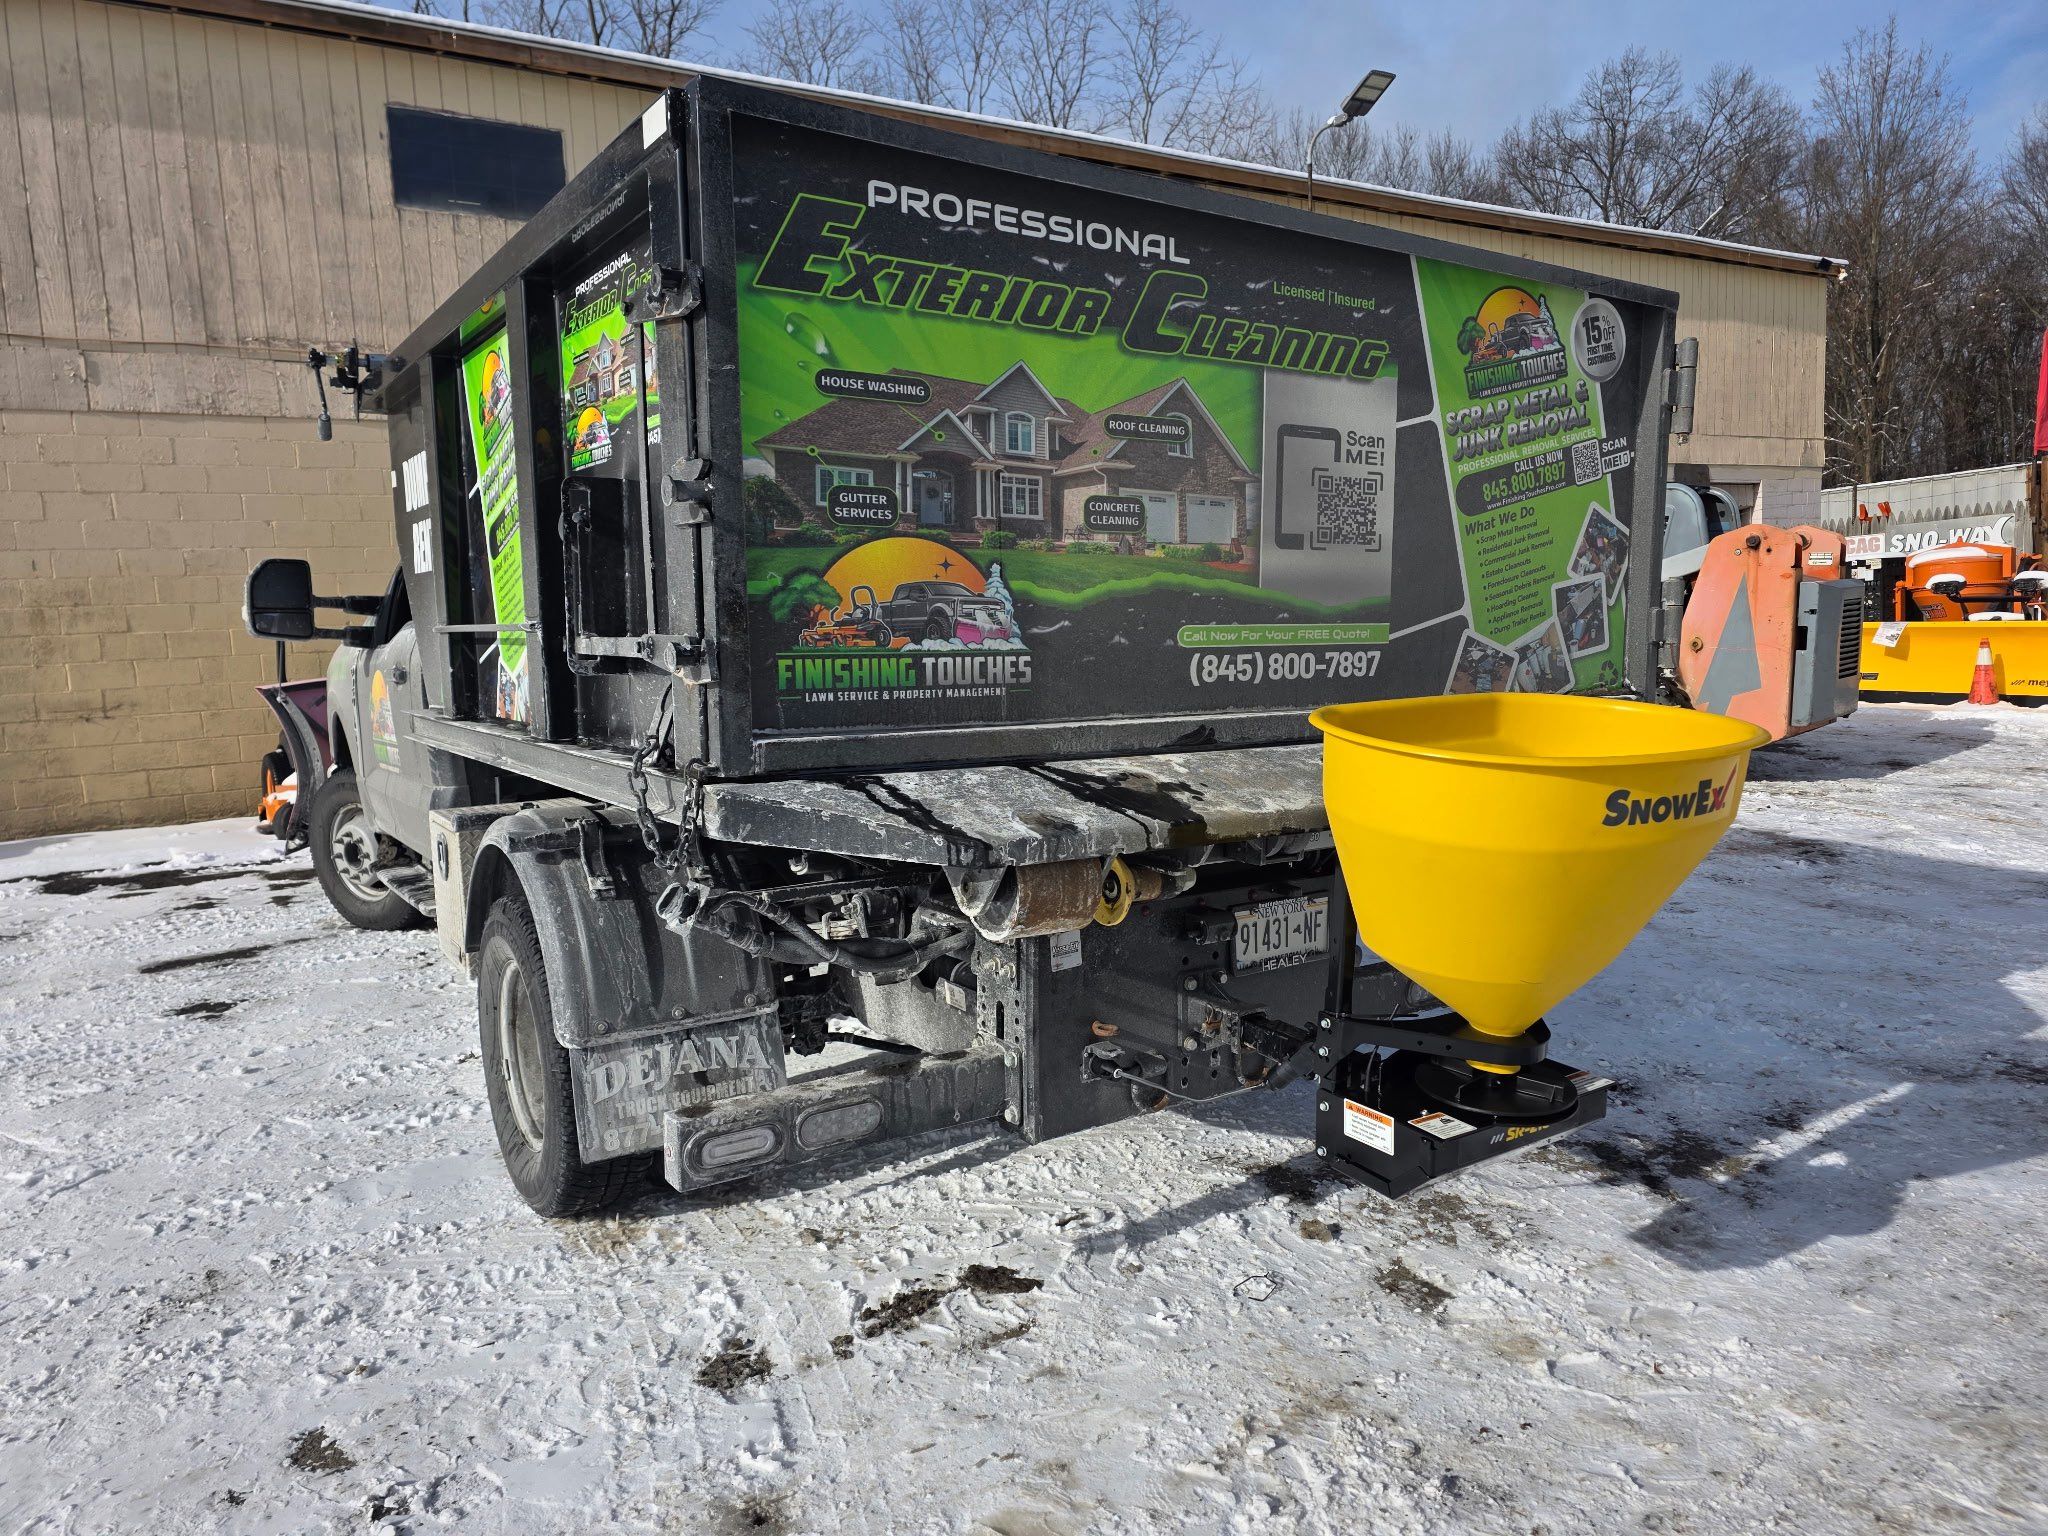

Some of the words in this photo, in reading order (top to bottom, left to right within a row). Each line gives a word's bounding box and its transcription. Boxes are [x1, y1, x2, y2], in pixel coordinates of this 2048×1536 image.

[868, 180, 1190, 264] PROFESSIONAL
[575, 252, 632, 297] PROFESSIONAL
[753, 193, 1111, 335] EXTERIOR
[1122, 270, 1389, 378] CLEANING
[1273, 281, 1325, 302] Licensed
[1334, 292, 1376, 310] Insured
[1602, 326, 1615, 341] OFF
[1467, 363, 1520, 392] FINISHING
[1520, 352, 1566, 379] TOUCHES
[821, 375, 865, 390] HOUSE
[867, 381, 925, 396] WASHING
[1446, 399, 1510, 436] SCRAP
[1514, 383, 1573, 419] METAL
[1108, 419, 1137, 432] ROOF
[1138, 422, 1185, 436] CLEANING
[1453, 426, 1504, 462] JUNK
[1507, 404, 1591, 447] REMOVAL
[1346, 430, 1385, 449] Scan
[1602, 437, 1628, 453] SCAN
[1345, 449, 1385, 466] ME!
[1457, 449, 1520, 474] PROFESSIONAL
[1522, 441, 1560, 456] REMOVAL
[1561, 428, 1597, 444] SERVICES
[1514, 460, 1534, 473] CALL
[1535, 456, 1546, 467] US
[1546, 449, 1564, 463] NOW
[1482, 461, 1567, 502] 845.800.7897
[839, 492, 887, 504] GUTTER
[1089, 501, 1141, 513] CONCRETE
[834, 506, 893, 520] SERVICES
[1090, 515, 1139, 526] CLEANING
[1465, 517, 1497, 537] What
[1499, 511, 1517, 526] We
[1520, 506, 1535, 519] Do
[1480, 533, 1497, 544] Scrap
[1514, 519, 1538, 533] Removal
[1482, 539, 1513, 555] Residential
[1183, 631, 1207, 641] Call
[1211, 631, 1238, 641] Now
[1241, 630, 1261, 640] For
[1265, 630, 1295, 640] Your
[1297, 629, 1330, 639] FREE
[1333, 629, 1371, 639] Quote!
[777, 657, 916, 690] FINISHING
[922, 655, 1032, 687] TOUCHES
[1189, 652, 1264, 687] (845)
[1268, 650, 1382, 681] 800-7897
[805, 692, 834, 703] LAWN
[837, 690, 879, 701] SERVICE
[882, 690, 890, 700] &
[893, 688, 943, 699] PROPERTY
[946, 687, 1007, 698] MANAGEMENT
[1256, 908, 1279, 920] NEW
[1281, 901, 1306, 916] YORK
[1262, 953, 1307, 972] HEALEY
[589, 1034, 773, 1105] DEJANA
[615, 1092, 668, 1119] TRUCK
[673, 1076, 754, 1110] EQUIPMENT
[1355, 1106, 1383, 1123] WARNING
